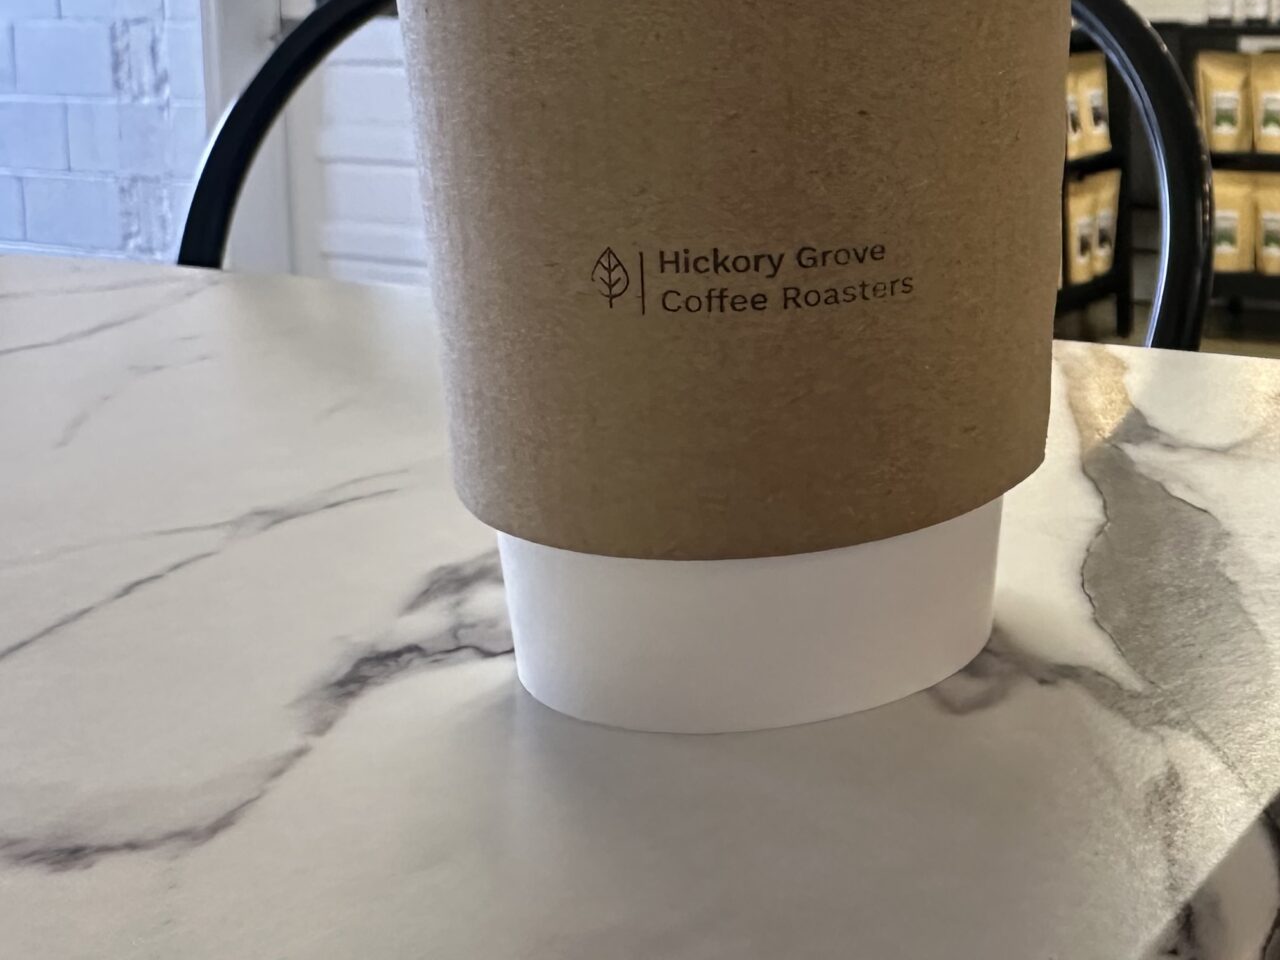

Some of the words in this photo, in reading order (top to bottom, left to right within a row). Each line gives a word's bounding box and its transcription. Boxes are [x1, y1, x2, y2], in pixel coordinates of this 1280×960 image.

[658, 247, 785, 279] Hickory
[795, 243, 886, 270] Grove
[660, 287, 769, 313] Coffee
[782, 275, 915, 311] Roasters
